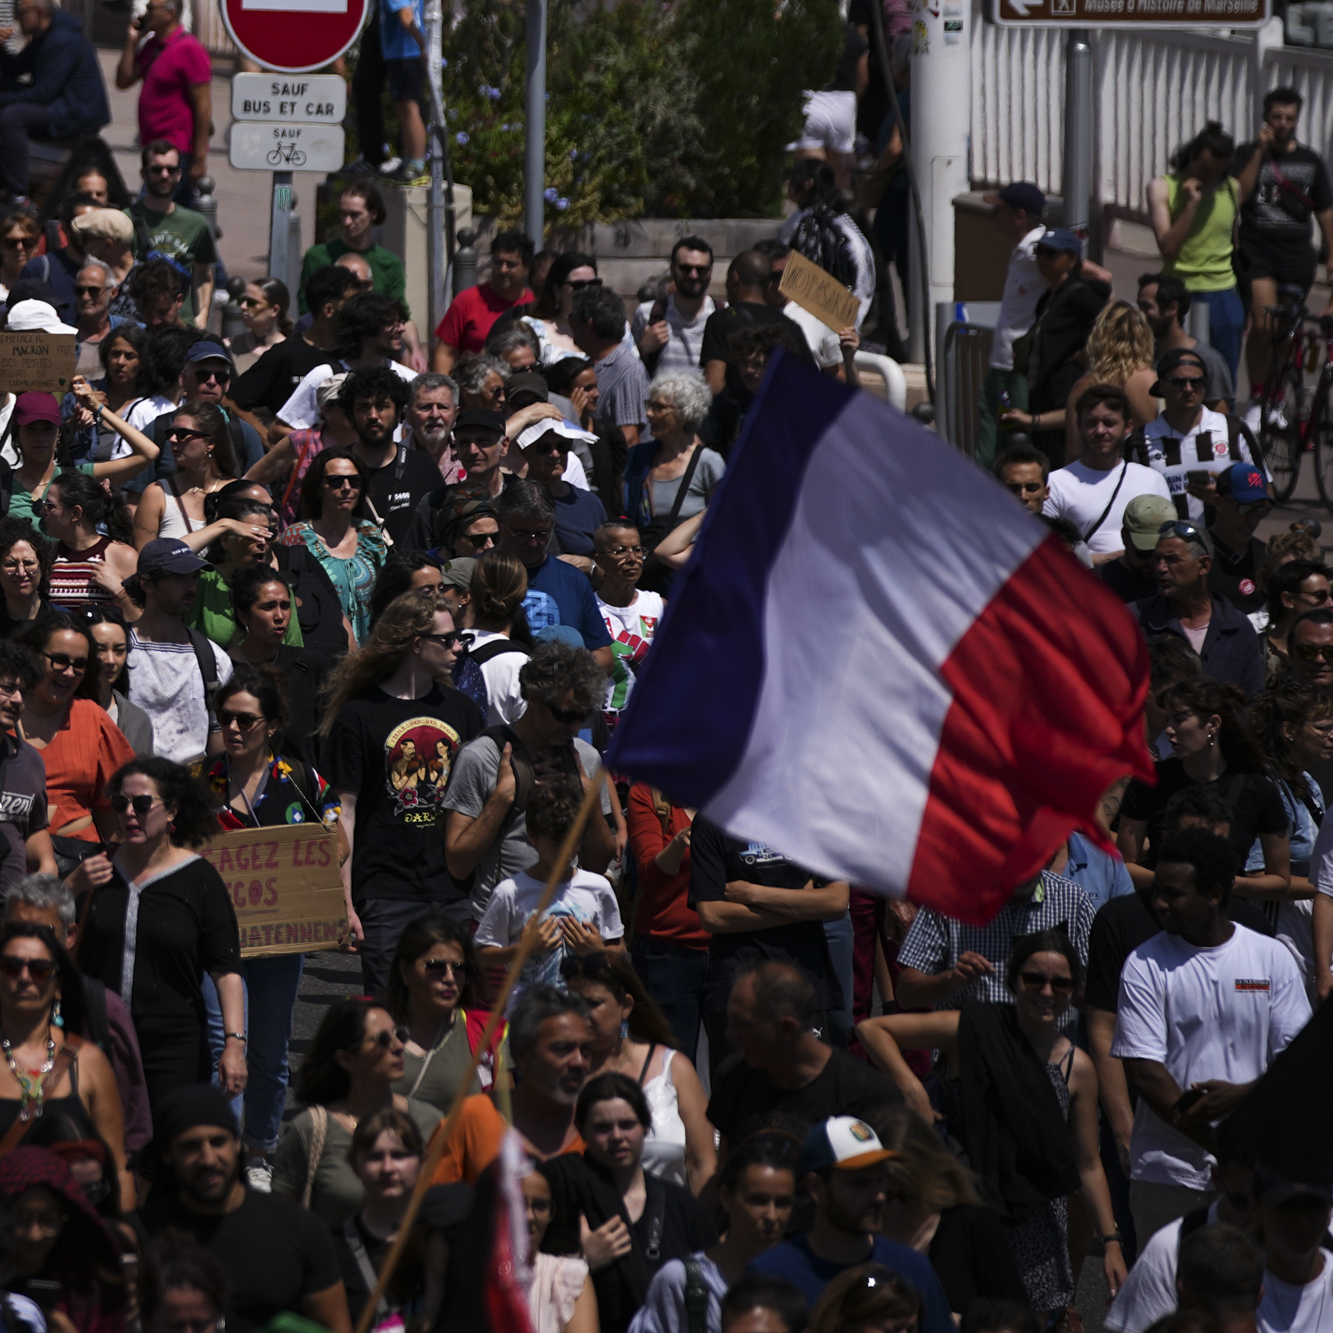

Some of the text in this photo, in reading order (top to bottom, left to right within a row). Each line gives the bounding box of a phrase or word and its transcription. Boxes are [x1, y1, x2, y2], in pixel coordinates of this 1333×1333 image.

[271, 81, 310, 98] SAUF
[243, 99, 335, 116] BUS ET CAR
[273, 128, 302, 139] SAUF
[13, 345, 50, 356] MACRON
[292, 839, 331, 868] LES
